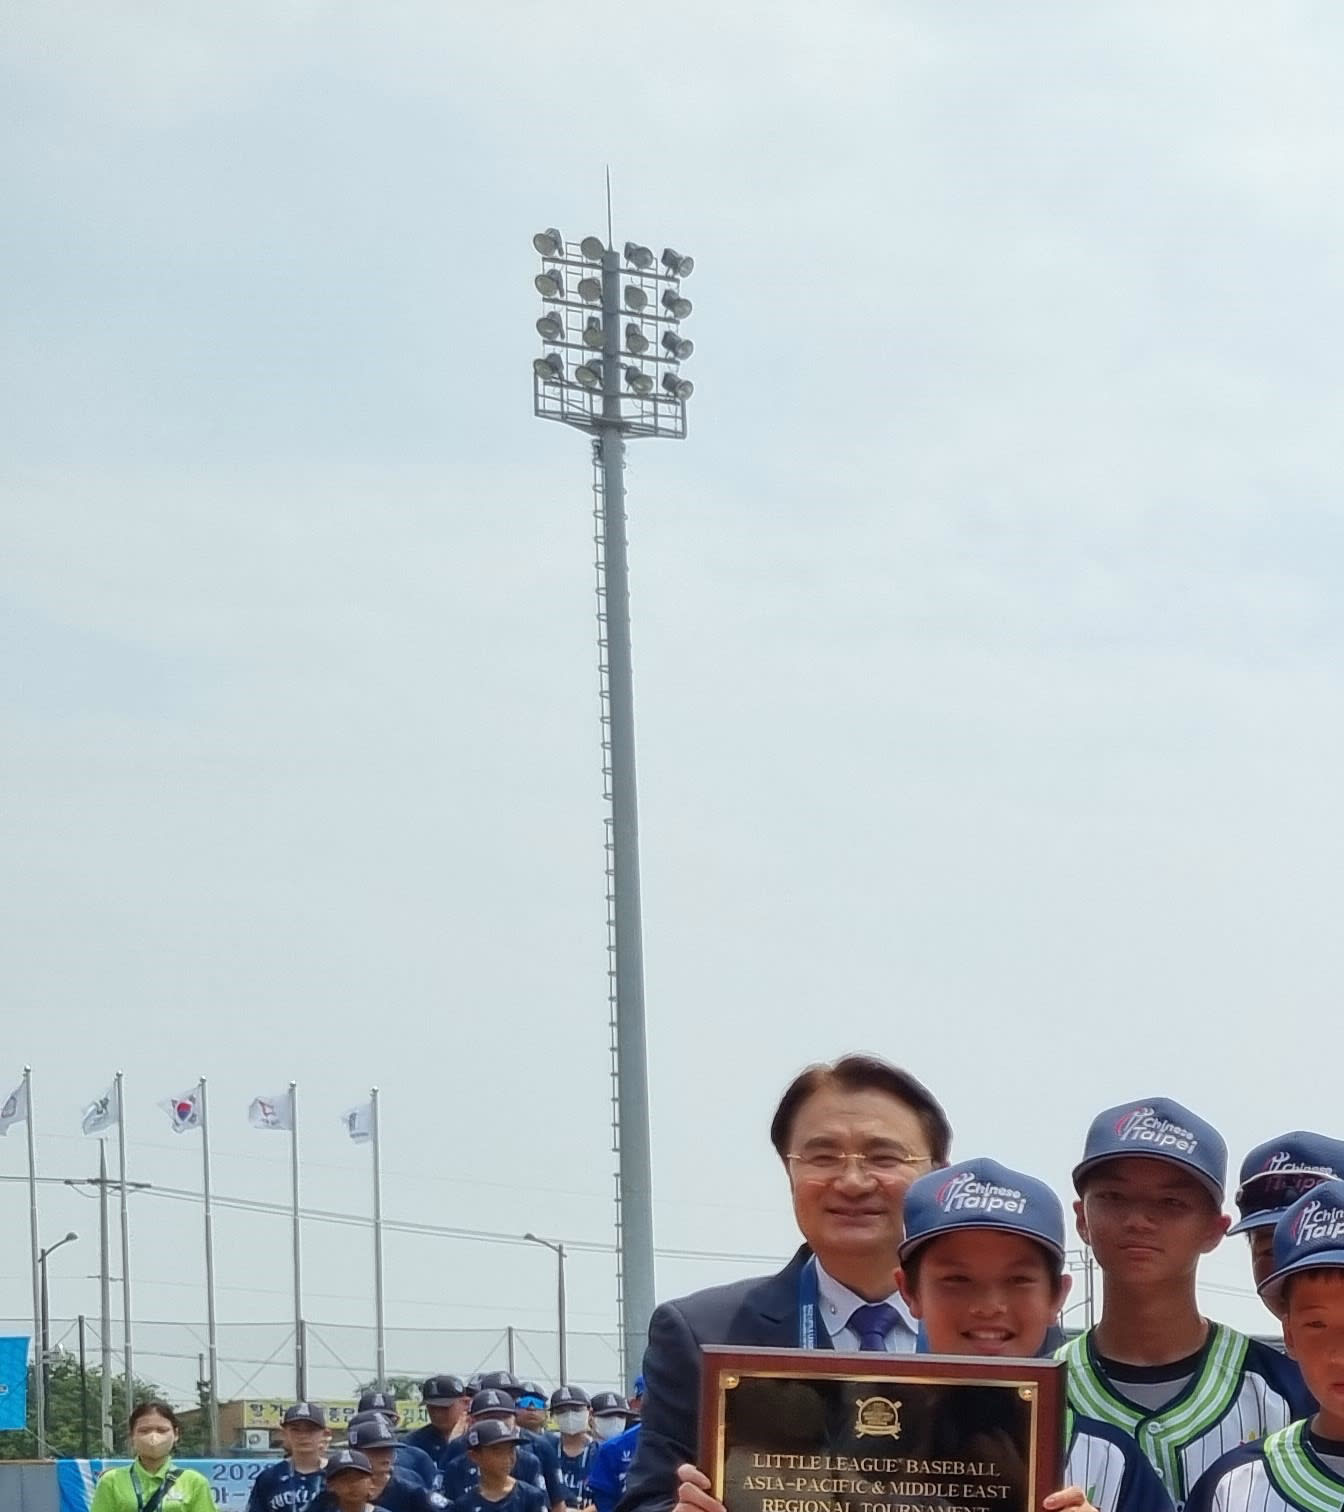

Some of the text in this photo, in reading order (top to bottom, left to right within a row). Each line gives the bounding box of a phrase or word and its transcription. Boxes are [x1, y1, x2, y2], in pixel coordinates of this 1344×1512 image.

[1131, 1126, 1198, 1154] Taipei
[1142, 1117, 1194, 1140] Chinese
[964, 1182, 1021, 1199] Chinese
[953, 1192, 1027, 1214] Taipei
[754, 1454, 1000, 1477] LITTLE LEAGUE BASEBALL
[744, 1476, 1010, 1499] ASIA-PACIFIC & MIDDLE EAST
